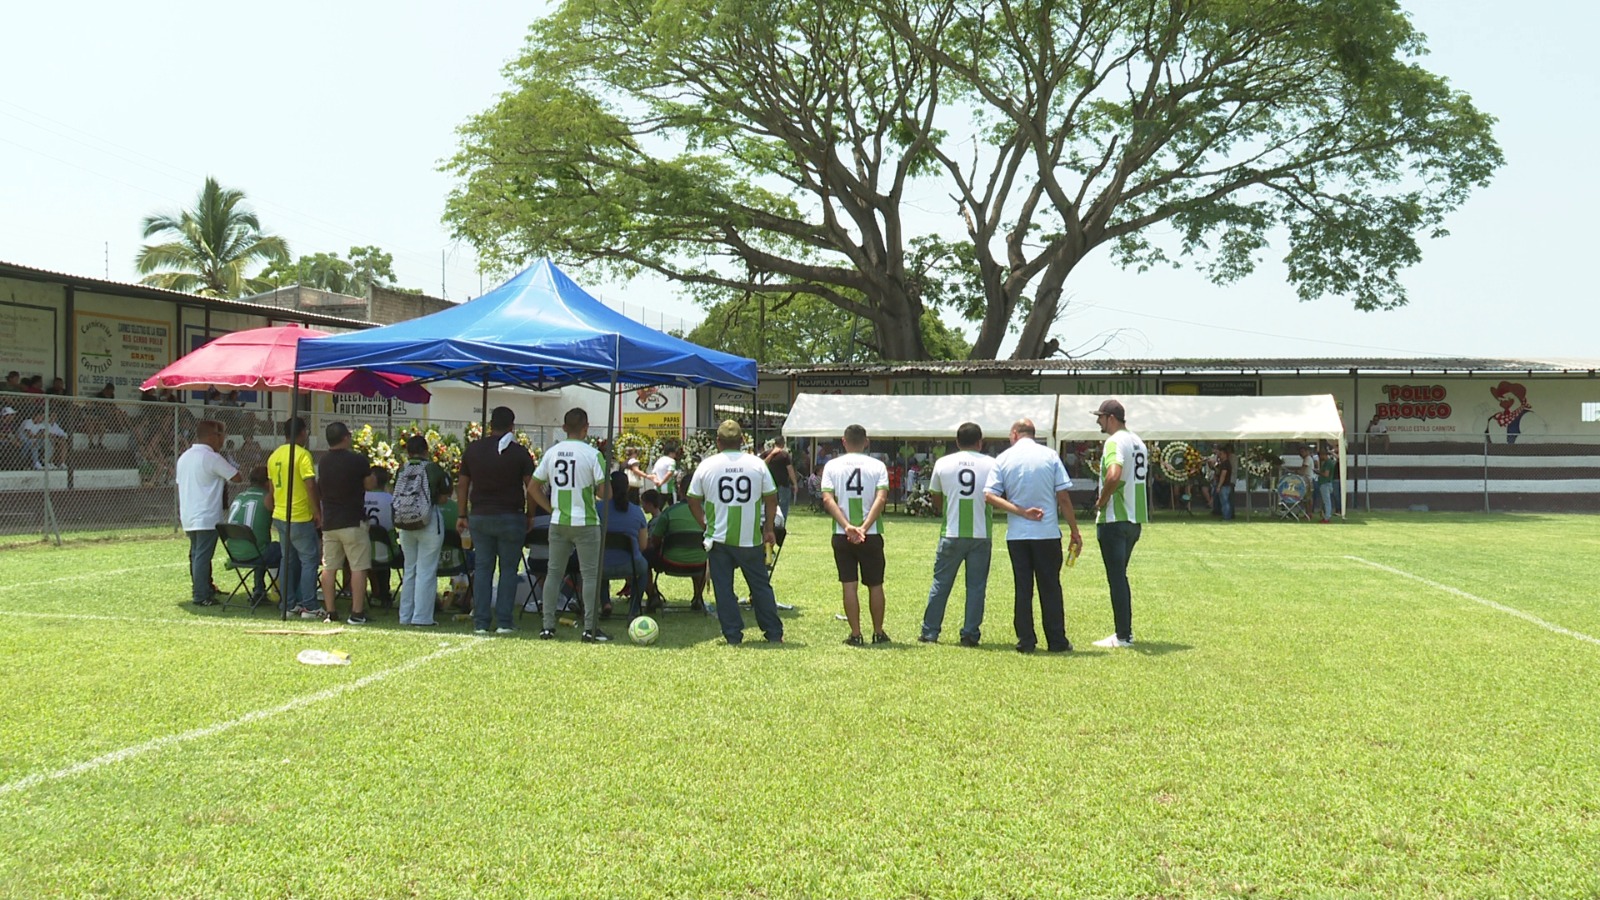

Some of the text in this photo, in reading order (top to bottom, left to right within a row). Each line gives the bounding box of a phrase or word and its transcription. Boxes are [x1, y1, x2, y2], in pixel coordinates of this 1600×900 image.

[81, 357, 113, 373] CASTILLO
[131, 353, 155, 361] GRATIS
[1383, 385, 1447, 402] POLLO
[1375, 403, 1452, 421] BRONCO
[554, 459, 577, 488] 31
[845, 468, 864, 495] 4
[958, 468, 976, 496] 9
[718, 475, 751, 504] 69
[228, 499, 258, 529] 21
